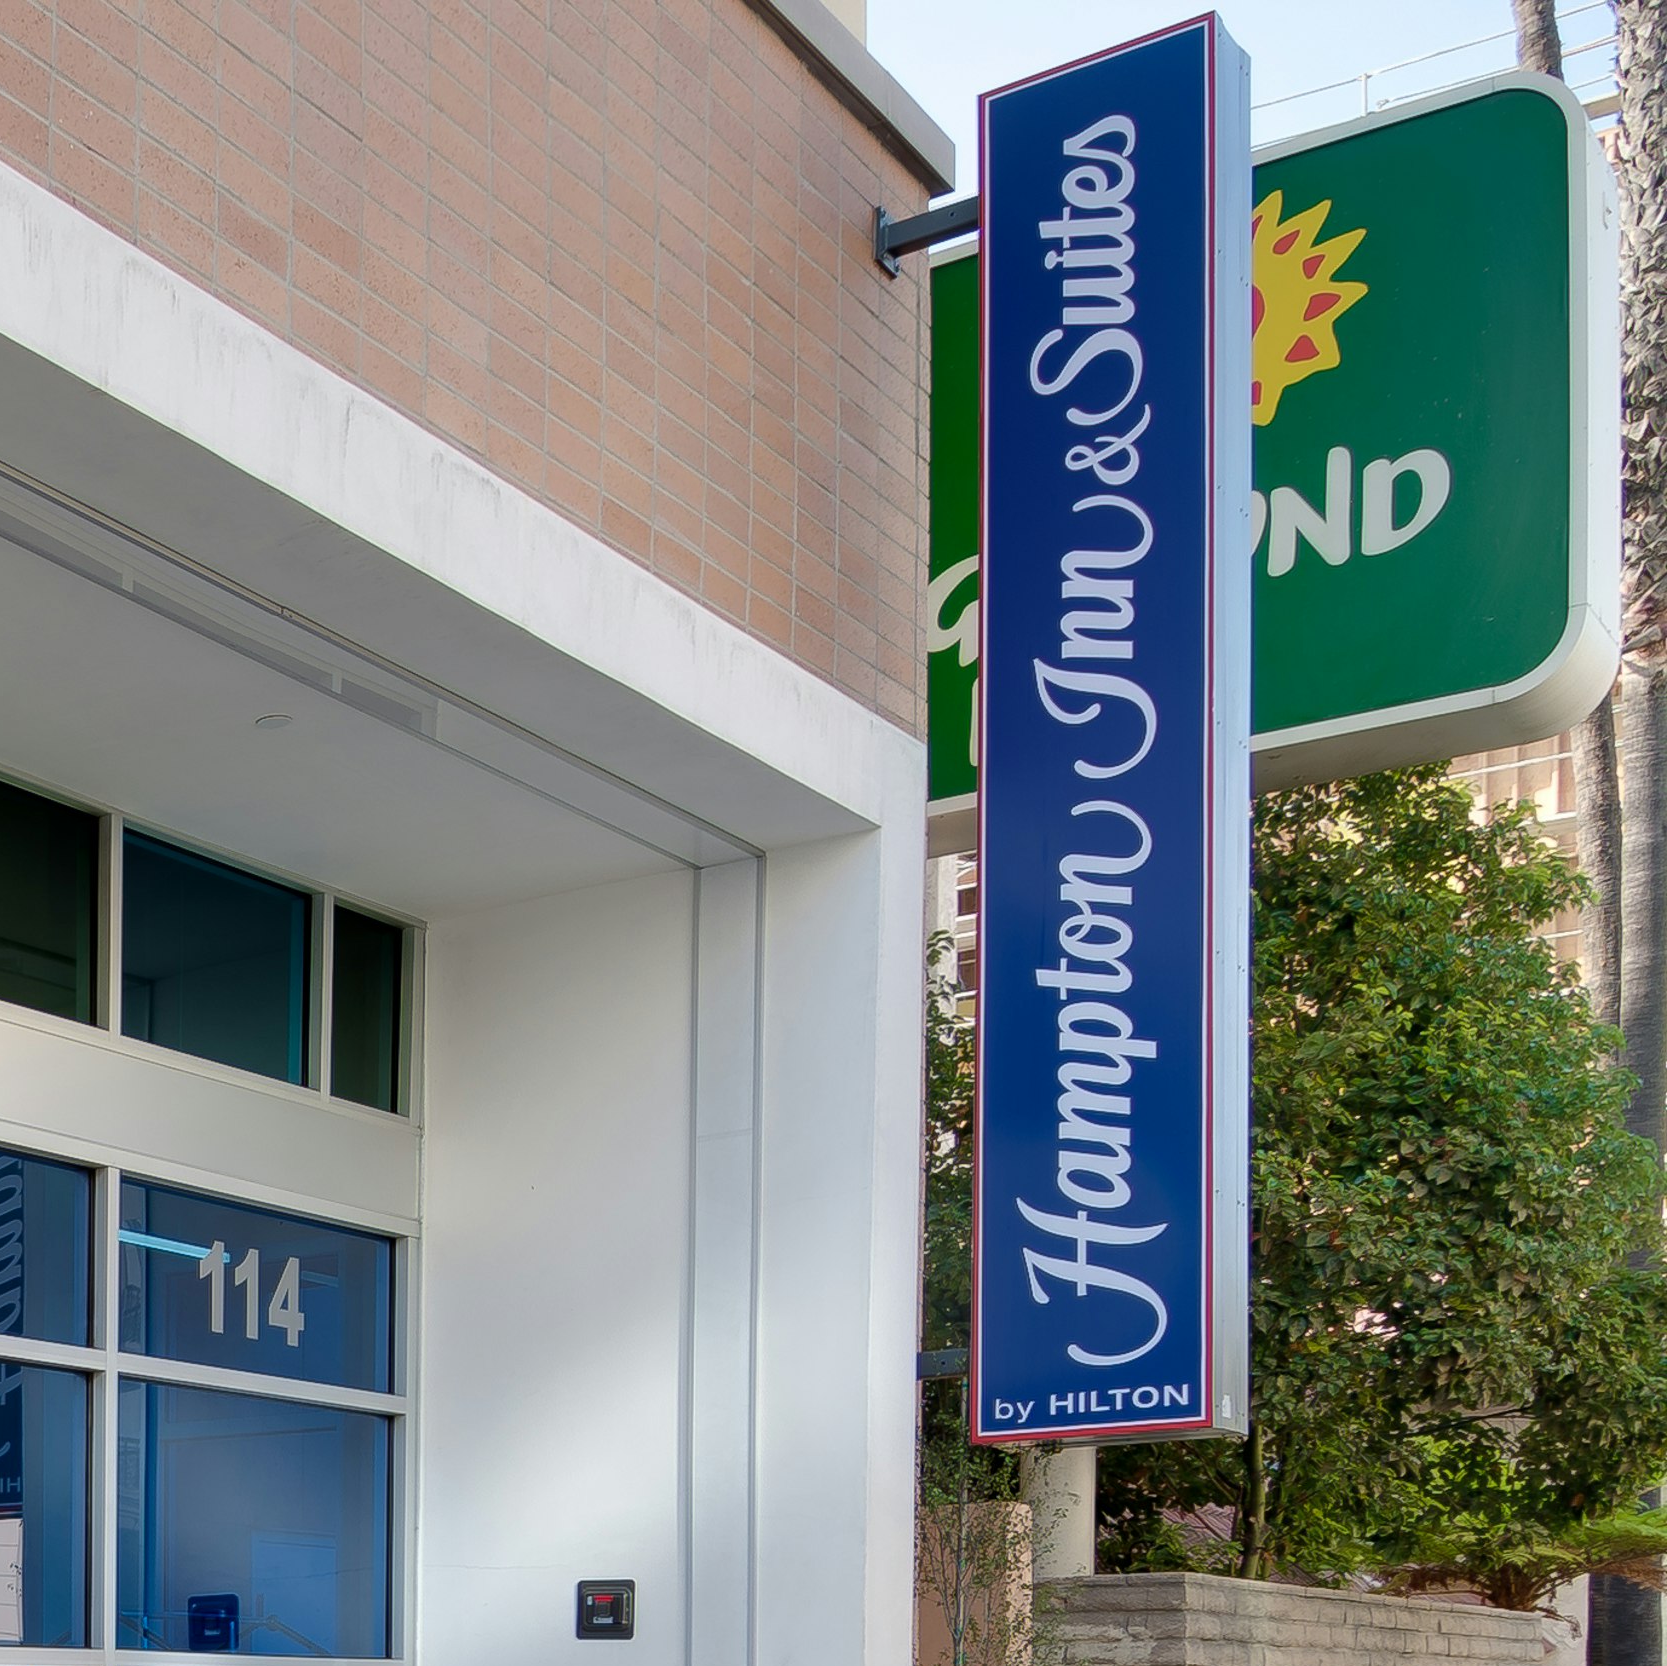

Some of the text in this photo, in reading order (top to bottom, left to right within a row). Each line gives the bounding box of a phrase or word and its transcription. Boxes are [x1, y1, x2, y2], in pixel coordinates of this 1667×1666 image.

[1015, 113, 1168, 1366] Hampton Inn & Suites
[197, 1239, 306, 1347] 114
[993, 1383, 1191, 1425] by HILTON
